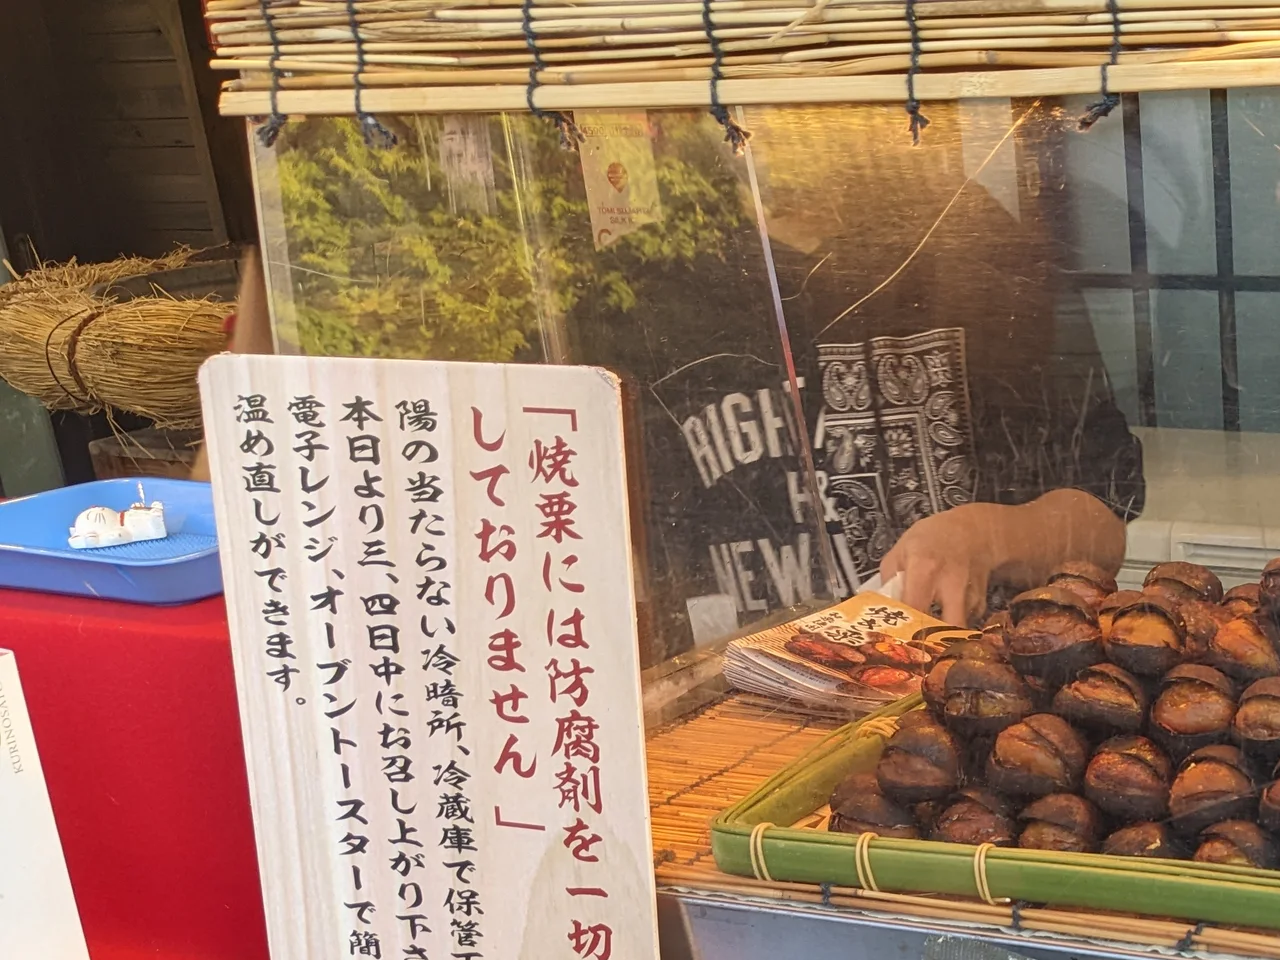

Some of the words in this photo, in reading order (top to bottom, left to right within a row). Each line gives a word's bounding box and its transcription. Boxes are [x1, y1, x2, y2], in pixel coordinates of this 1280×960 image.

[234, 394, 306, 706] 温め直しができます。
[470, 405, 546, 832] しておりません」
